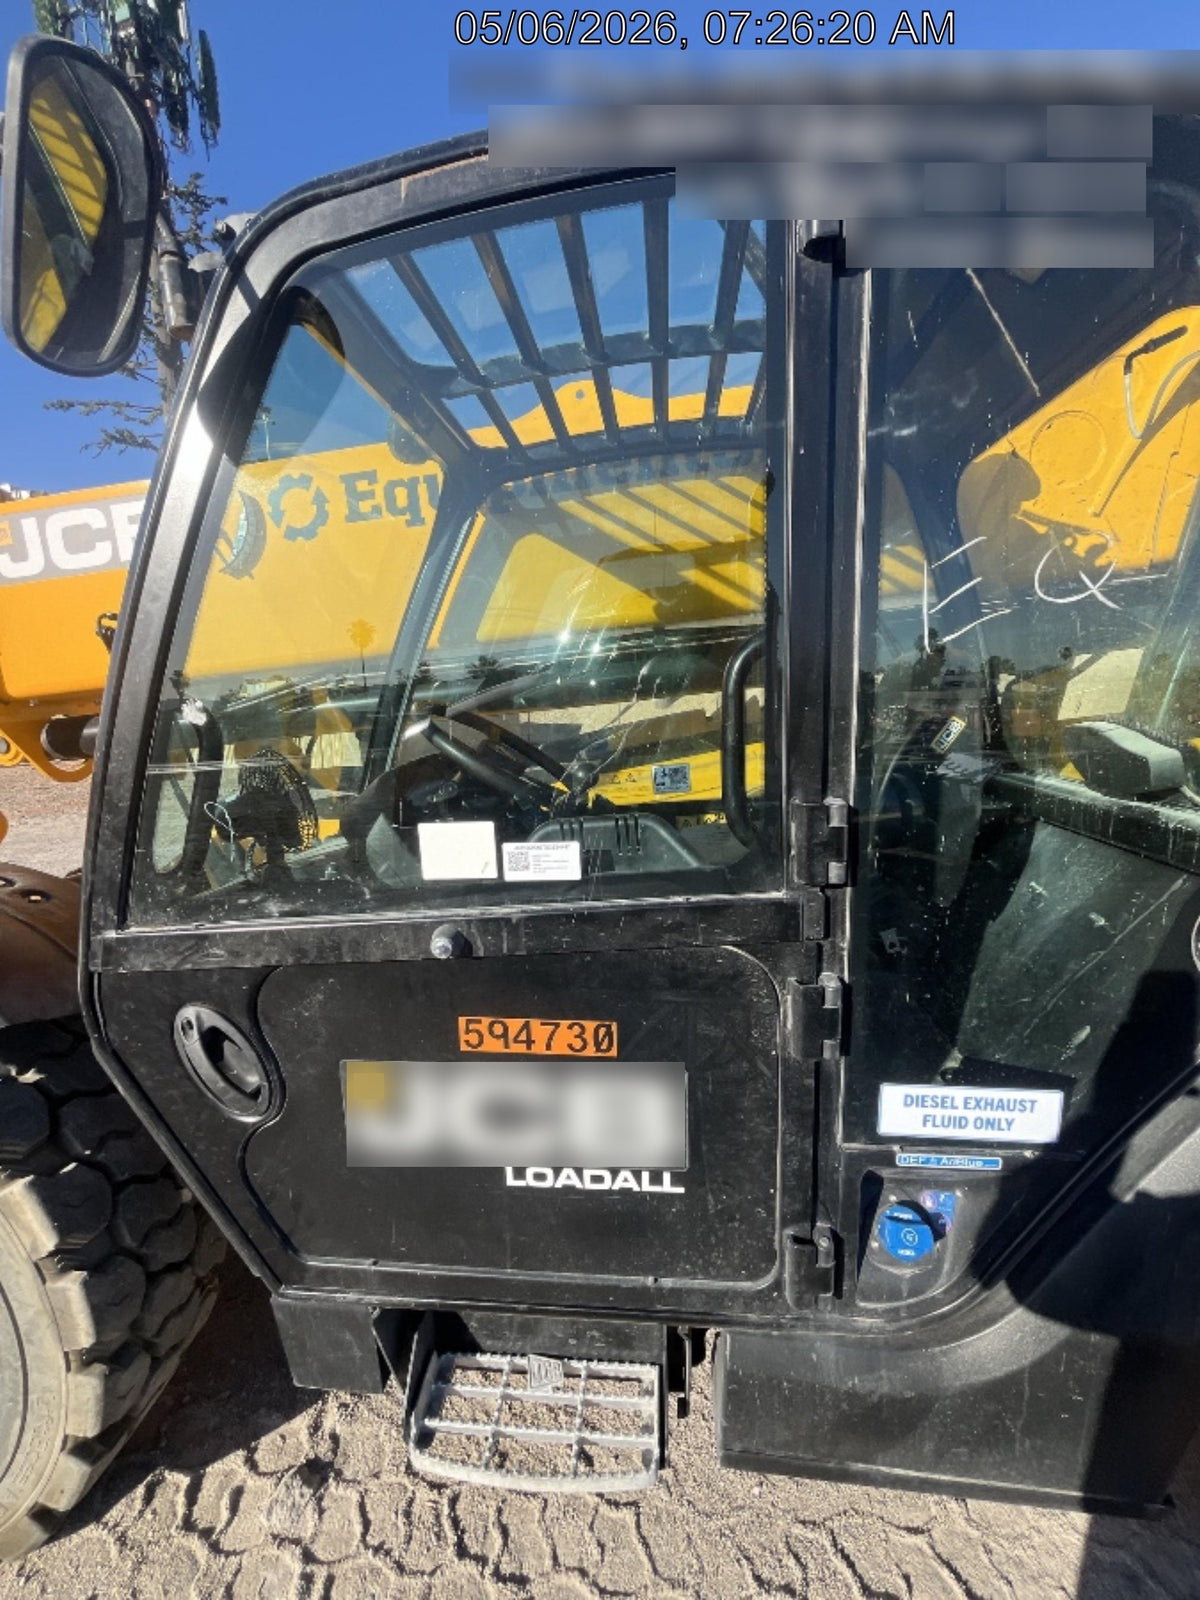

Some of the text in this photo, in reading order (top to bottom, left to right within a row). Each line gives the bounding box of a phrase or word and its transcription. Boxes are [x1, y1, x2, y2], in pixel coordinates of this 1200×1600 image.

[463, 1018, 614, 1054] 594730
[903, 1094, 1037, 1114] DIESEL EXHAUST
[922, 1114, 1016, 1132] FLUID ONLY
[505, 1166, 685, 1193] LOADALL
